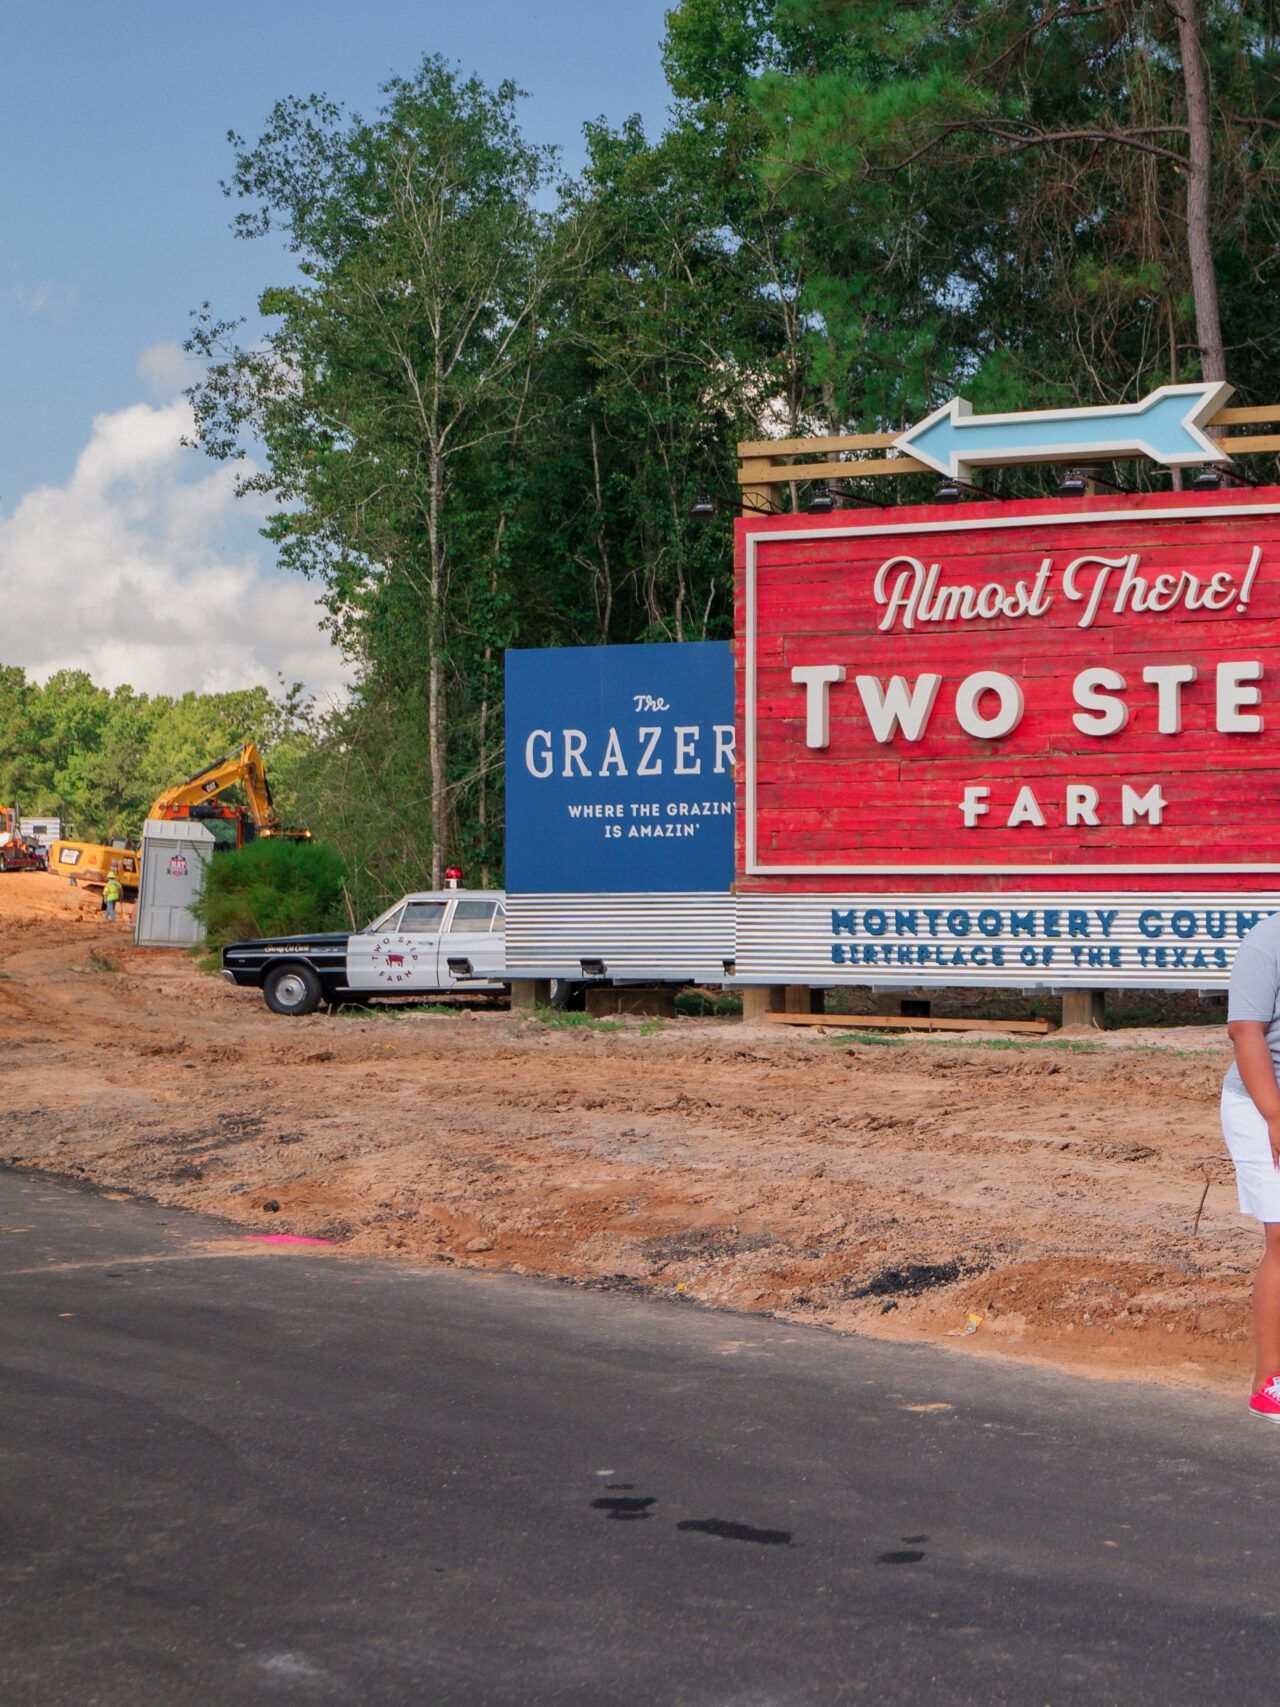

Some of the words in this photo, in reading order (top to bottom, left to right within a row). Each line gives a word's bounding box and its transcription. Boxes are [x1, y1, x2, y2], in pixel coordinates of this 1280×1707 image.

[873, 556, 1054, 631] Almost
[1062, 545, 1262, 628] There!
[633, 695, 670, 712] The
[790, 663, 1024, 748] TWO
[525, 725, 736, 778] GRAZER
[568, 804, 624, 818] WHERE
[630, 804, 660, 816] THE
[958, 783, 1169, 827] FARM
[604, 825, 622, 838] IS
[628, 823, 700, 837] AMAZIN'
[832, 908, 1118, 937] MONTGOMERY
[1138, 909, 1280, 938] COUN
[832, 943, 1006, 966] BIRTHPLACE
[1020, 945, 1056, 966] OF
[1071, 946, 1121, 967] THE
[1138, 946, 1228, 968] TEXAS
